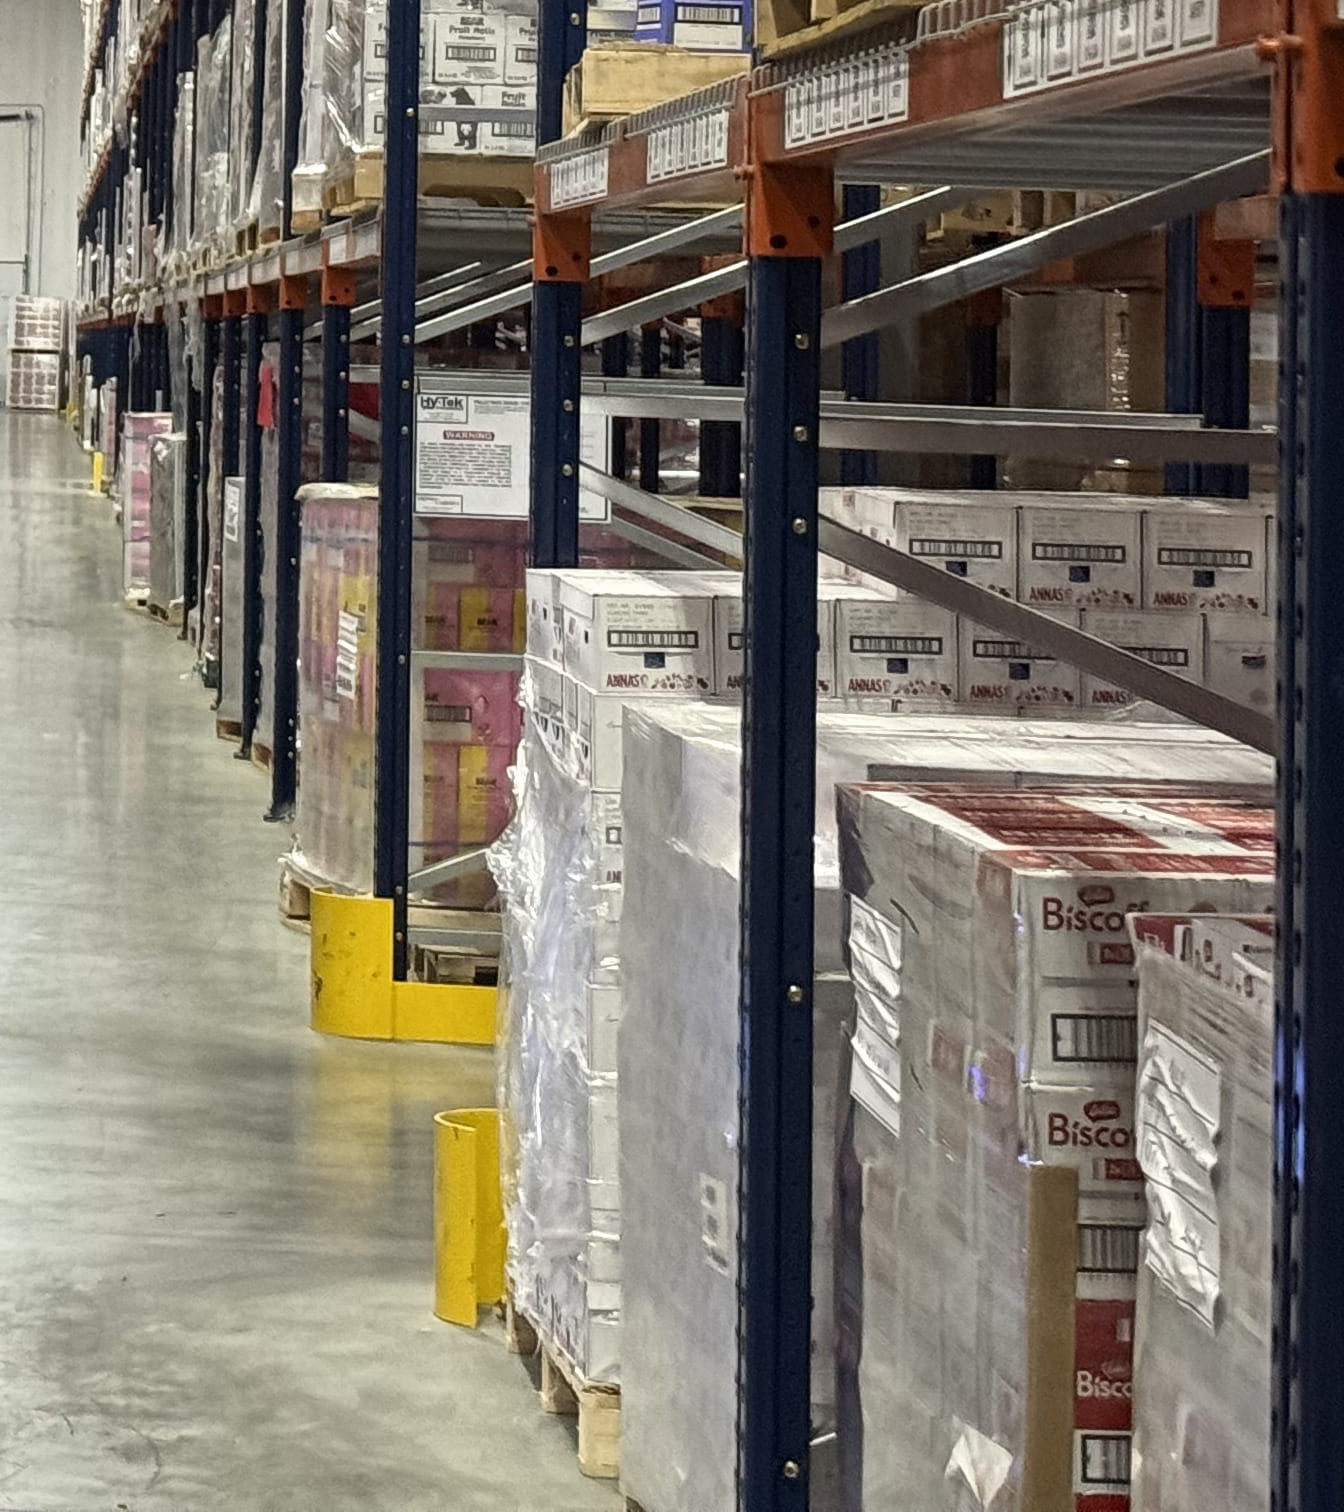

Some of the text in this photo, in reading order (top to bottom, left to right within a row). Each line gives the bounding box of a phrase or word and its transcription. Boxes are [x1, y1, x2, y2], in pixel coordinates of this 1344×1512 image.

[445, 431, 494, 441] WARNING
[1048, 1112, 1136, 1148] Bisco
[1076, 1370, 1132, 1397] Bisco
